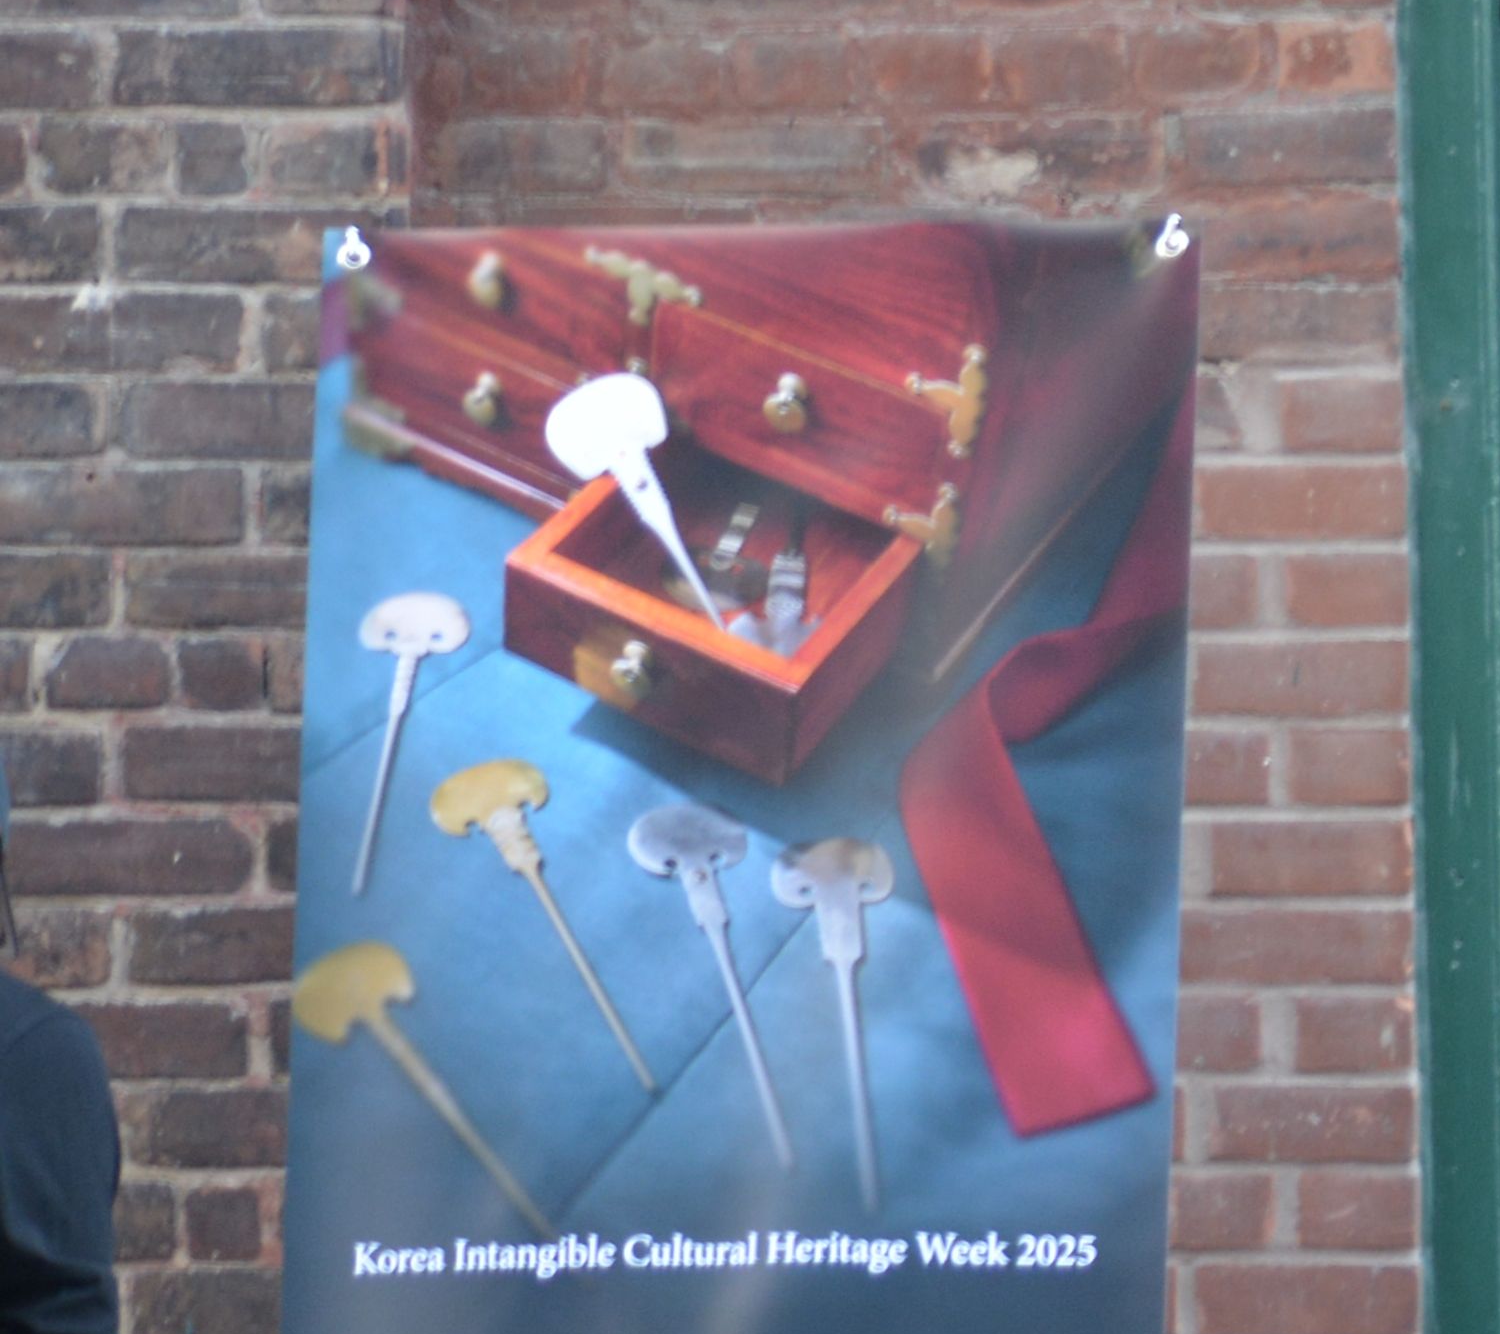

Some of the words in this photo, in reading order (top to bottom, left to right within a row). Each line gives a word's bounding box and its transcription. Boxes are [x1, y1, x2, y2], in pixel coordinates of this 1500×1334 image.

[353, 1240, 445, 1276] Korea
[453, 1233, 617, 1280] Intangible
[623, 1231, 758, 1268] Cultural
[766, 1229, 908, 1275] Heritage
[915, 1229, 1010, 1267] Week
[1016, 1232, 1098, 1268] 2025
